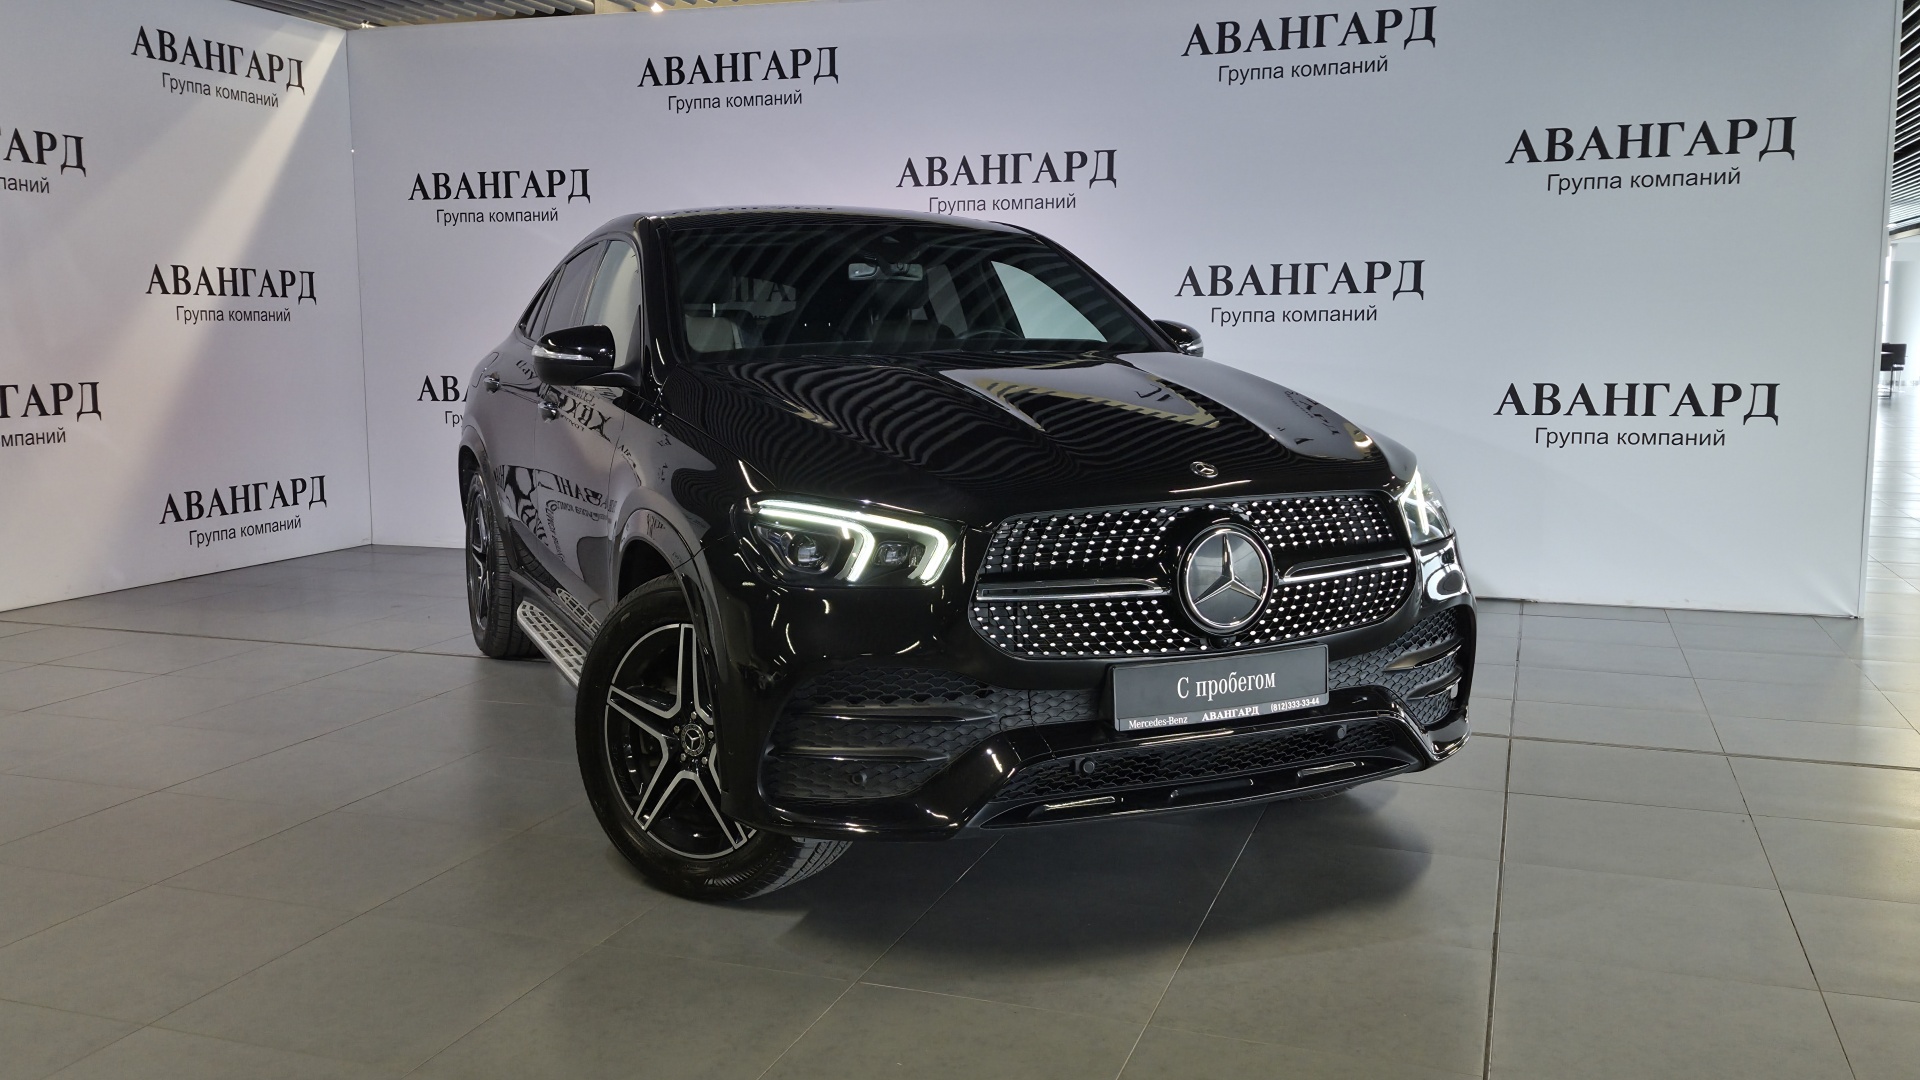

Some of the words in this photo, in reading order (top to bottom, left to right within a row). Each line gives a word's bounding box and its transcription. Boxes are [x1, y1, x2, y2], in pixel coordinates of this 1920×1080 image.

[1181, 5, 1438, 57] АВАНГАРД
[131, 25, 305, 94] АВАНГАРД
[637, 47, 839, 88] АВАНГАРД
[1219, 65, 1284, 86] Группа
[1292, 55, 1388, 78] компаний
[161, 72, 211, 96] Группа
[216, 86, 279, 108] компаний
[669, 96, 721, 115] Группа
[726, 89, 803, 108] компаний
[0, 127, 87, 178] АРД
[1505, 116, 1798, 165] АВАНГАРД
[896, 149, 1118, 190] АВАНГАРД
[1548, 174, 1622, 196] Группа
[1631, 167, 1741, 189] компаний
[408, 168, 591, 205] АВАНГАРД
[436, 209, 484, 227] Группа
[488, 207, 559, 223] компаний
[929, 196, 986, 216] Группа
[992, 193, 1076, 211] компаний
[146, 263, 318, 305] АВАНГАРД
[1174, 259, 1426, 302] АВАНГАРД
[176, 306, 224, 326] Группа
[228, 307, 291, 322] компаний
[1211, 307, 1276, 328] Группа
[1282, 305, 1378, 323] компаний
[1493, 382, 1781, 427] АВАНГАРД
[1, 427, 66, 447] мпаний
[1535, 427, 1609, 449] Группа
[1616, 429, 1726, 447] компаний
[159, 475, 328, 525] АВАНГАРД
[188, 529, 237, 548] Группа
[240, 515, 302, 538] компаний
[1196, 672, 1276, 702] пробегом
[1201, 706, 1261, 722] АВАНГАРД
[1270, 697, 1320, 712] (812)333-33-44
[1128, 716, 1189, 730] Mercedes-Benz
